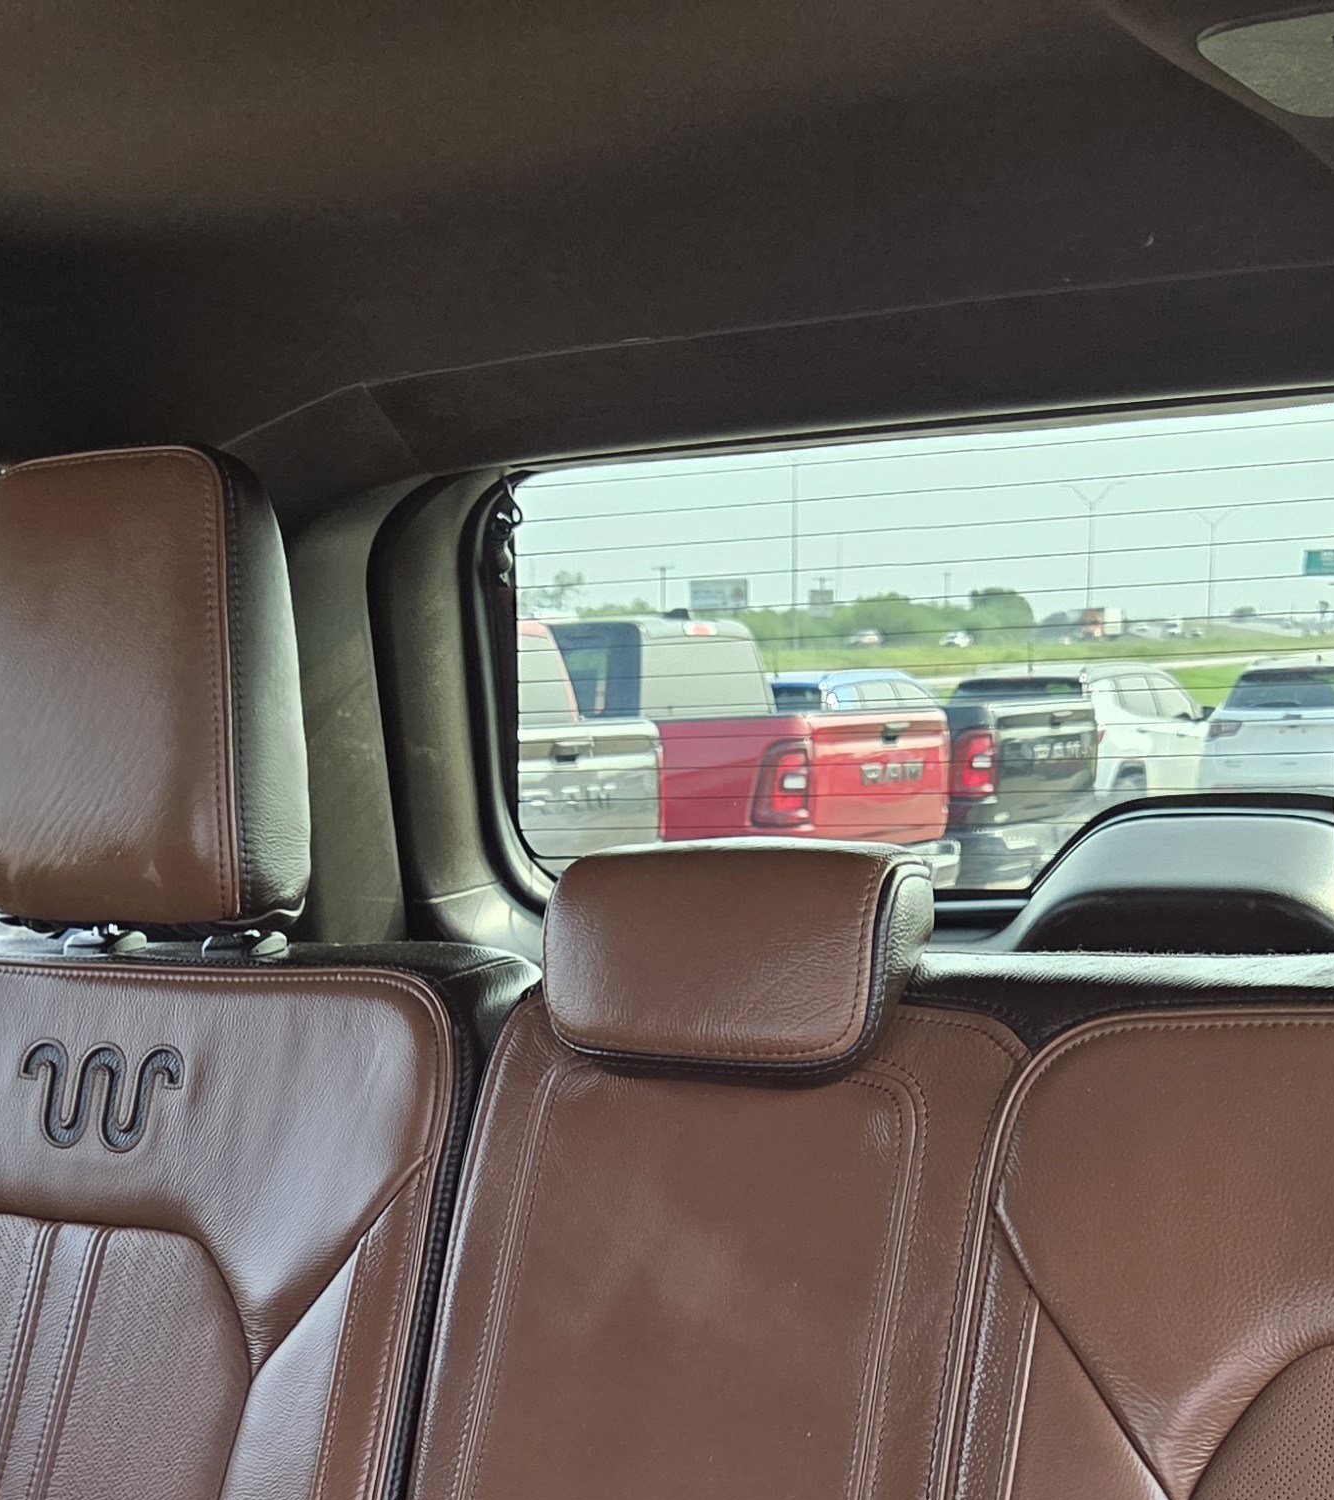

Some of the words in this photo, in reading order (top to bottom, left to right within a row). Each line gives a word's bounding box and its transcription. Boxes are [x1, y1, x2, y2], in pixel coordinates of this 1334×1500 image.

[1033, 742, 1081, 760] RAM
[861, 759, 924, 785] RAM
[521, 784, 618, 816] RAM
